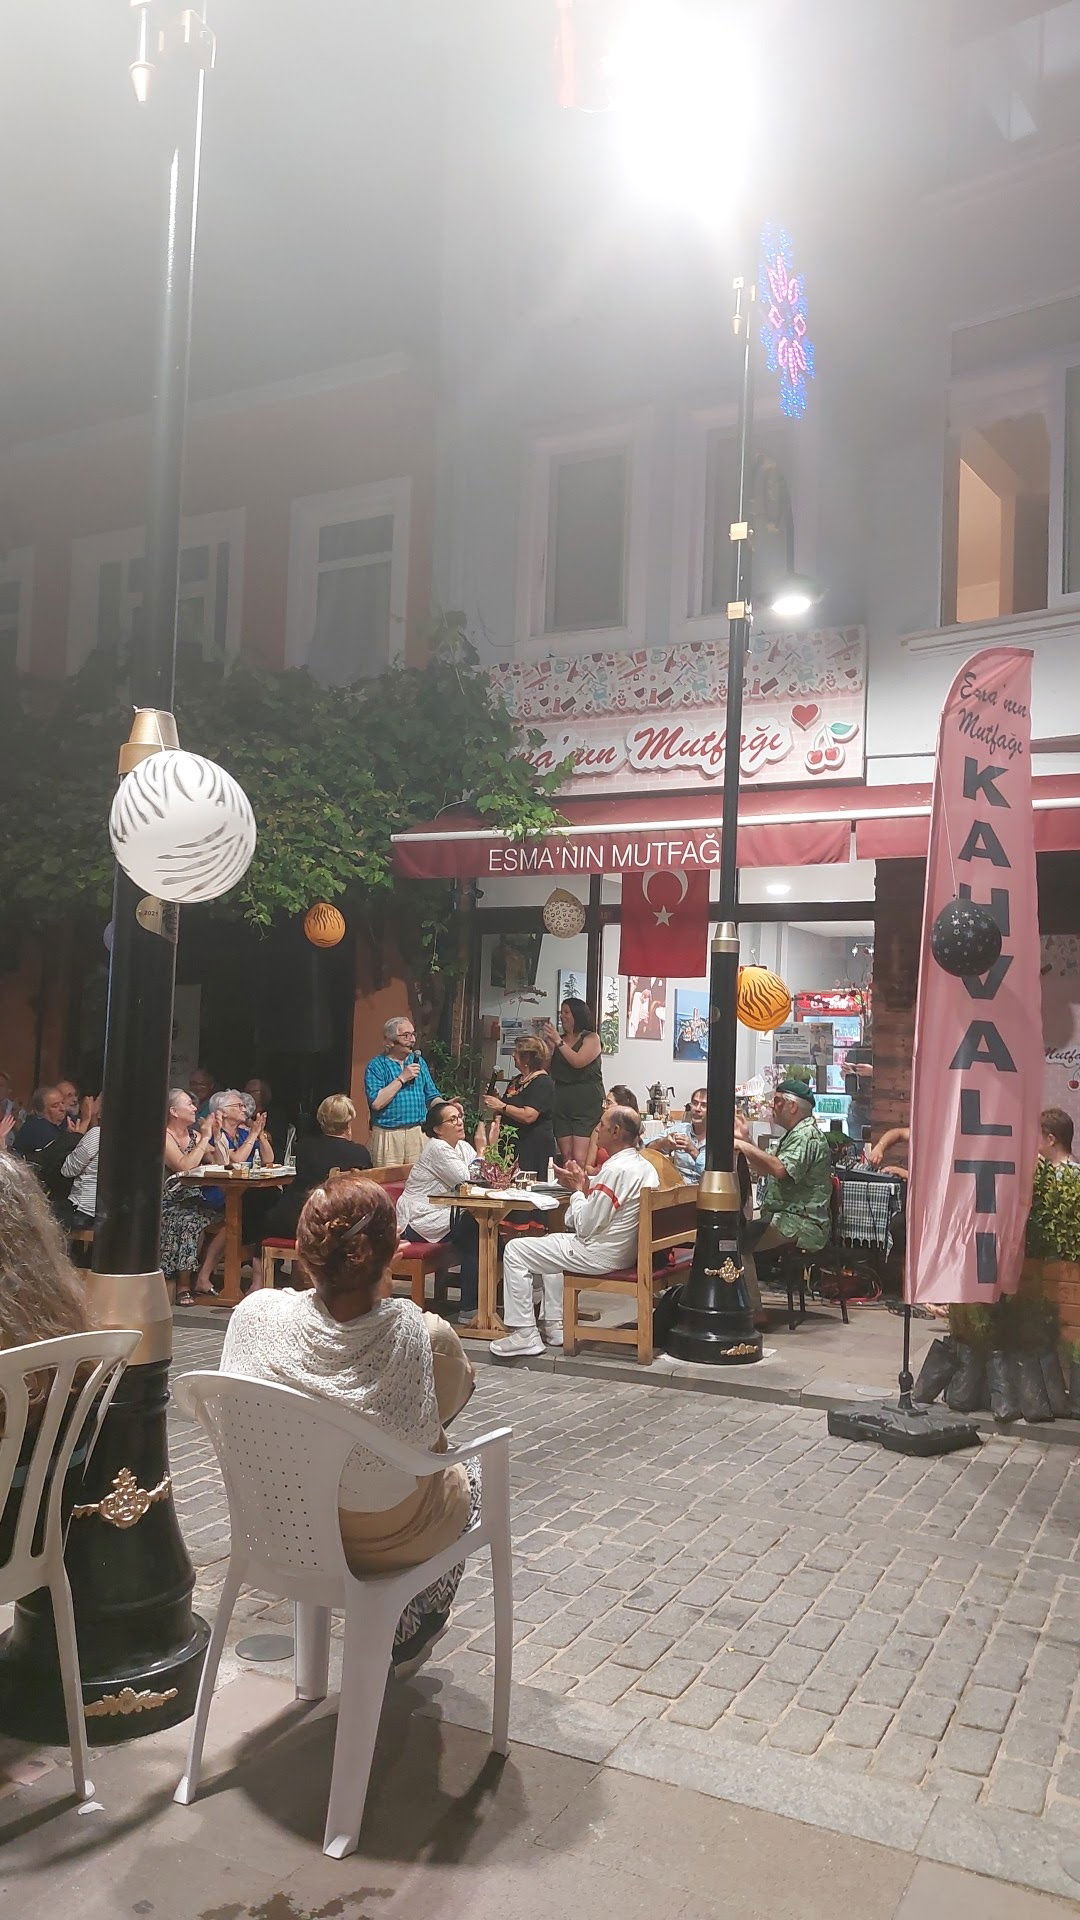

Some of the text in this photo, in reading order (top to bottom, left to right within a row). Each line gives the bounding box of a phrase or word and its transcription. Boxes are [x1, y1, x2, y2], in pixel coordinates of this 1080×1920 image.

[958, 707, 1023, 760] Mutfağı
[489, 832, 721, 872] ESMA'NIN MUTFAĞ
[948, 755, 1017, 1284] KAHVALTI
